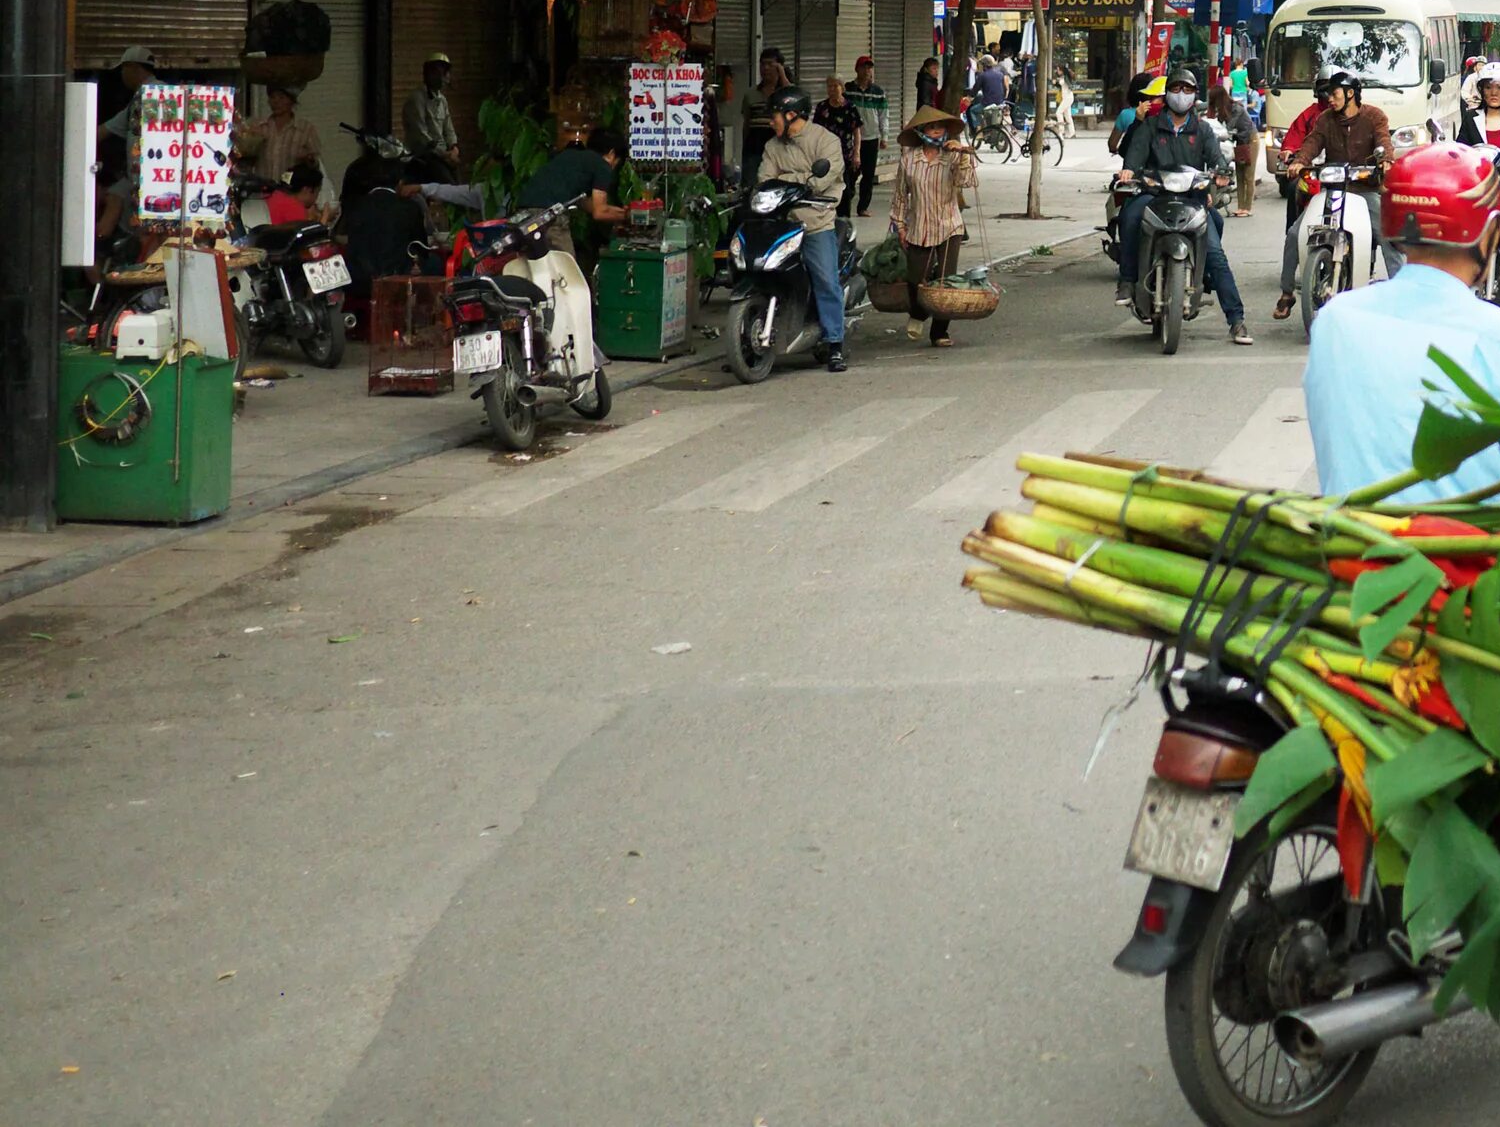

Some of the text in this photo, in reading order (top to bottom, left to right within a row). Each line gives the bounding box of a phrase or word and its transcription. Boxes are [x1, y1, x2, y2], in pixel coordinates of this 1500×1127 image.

[632, 68, 649, 83] BỌC
[652, 68, 673, 81] CHA
[152, 165, 219, 184] XE MÁY
[1391, 193, 1440, 207] HONDA
